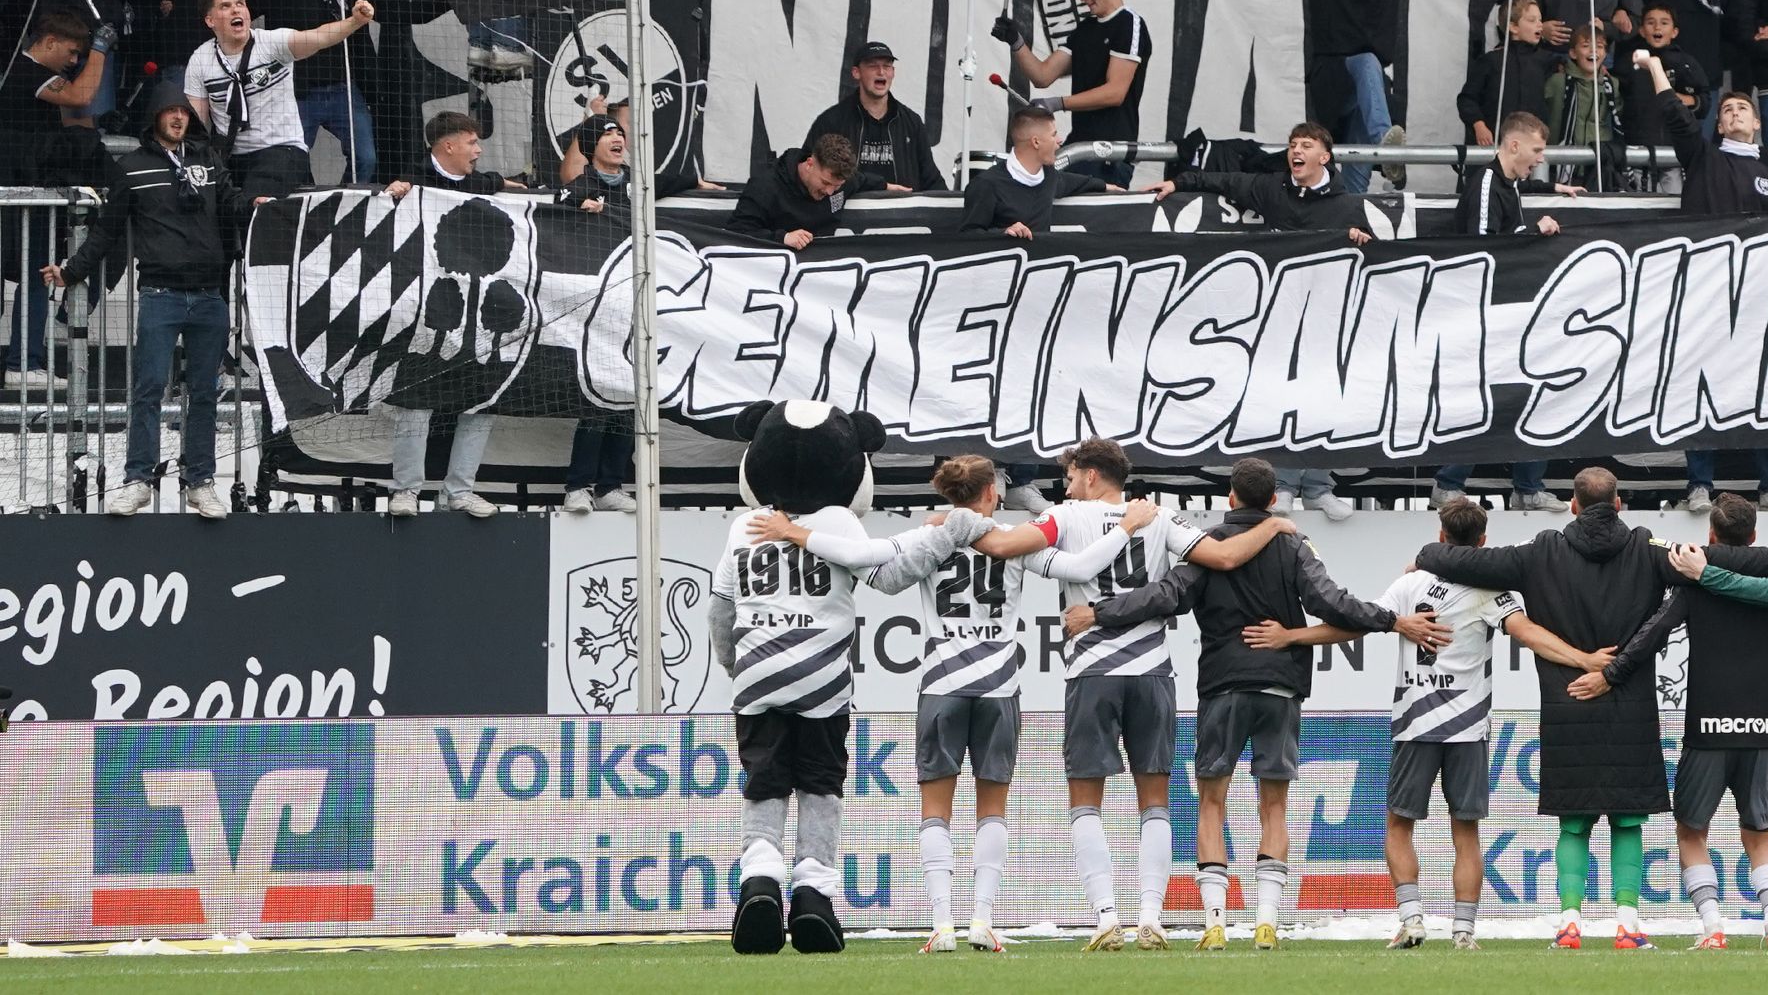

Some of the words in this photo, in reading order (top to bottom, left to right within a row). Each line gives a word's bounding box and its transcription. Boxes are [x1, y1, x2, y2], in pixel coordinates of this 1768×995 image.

[582, 228, 1494, 457] GEMEINSAM
[733, 542, 832, 597] 1916
[936, 552, 1006, 618] 24
[435, 719, 900, 803] Volksbk
[441, 831, 892, 915] Kraichu
